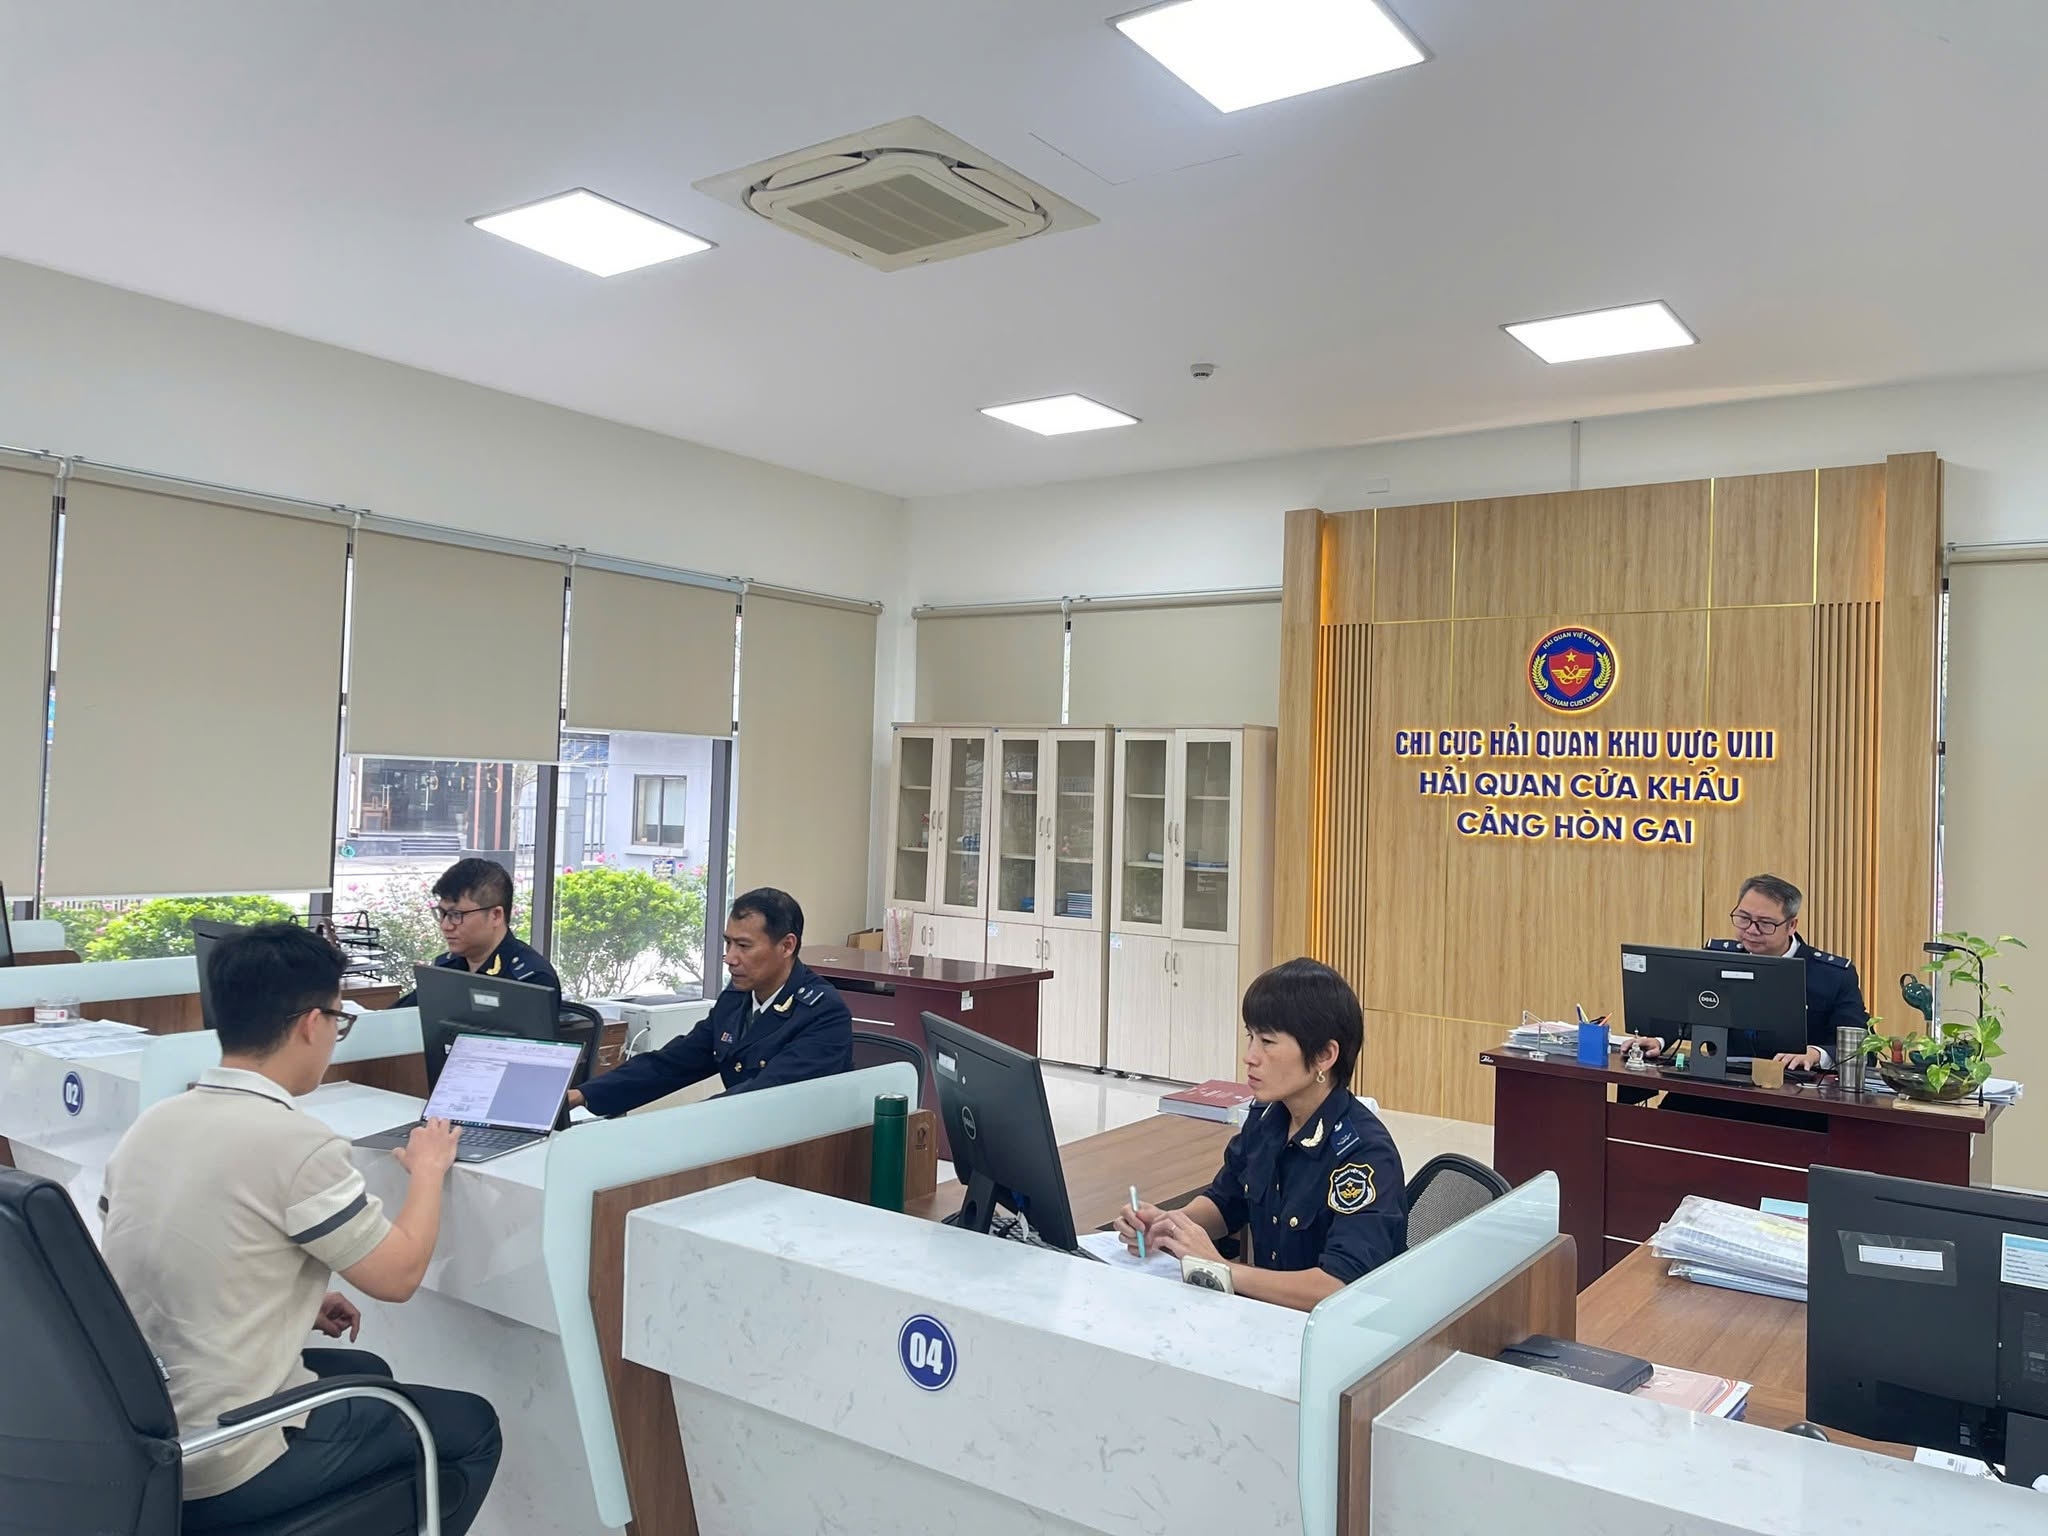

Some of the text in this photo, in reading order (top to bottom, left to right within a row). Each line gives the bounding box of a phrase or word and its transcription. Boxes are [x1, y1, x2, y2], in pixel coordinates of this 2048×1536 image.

[1553, 632, 1572, 642] QUAN
[1587, 635, 1601, 648] NAM
[1543, 691, 1600, 707] VIETNAM CUSTOMS
[1395, 723, 1773, 764] CHI CỤC HẢI QUAN KHU VỰC VIII
[1419, 766, 1740, 801] HẢI QUAN CỬA KHẨU
[1456, 805, 1692, 844] CẢNG HÒN GAI
[66, 1082, 79, 1106] 02
[909, 1331, 944, 1376] 04
